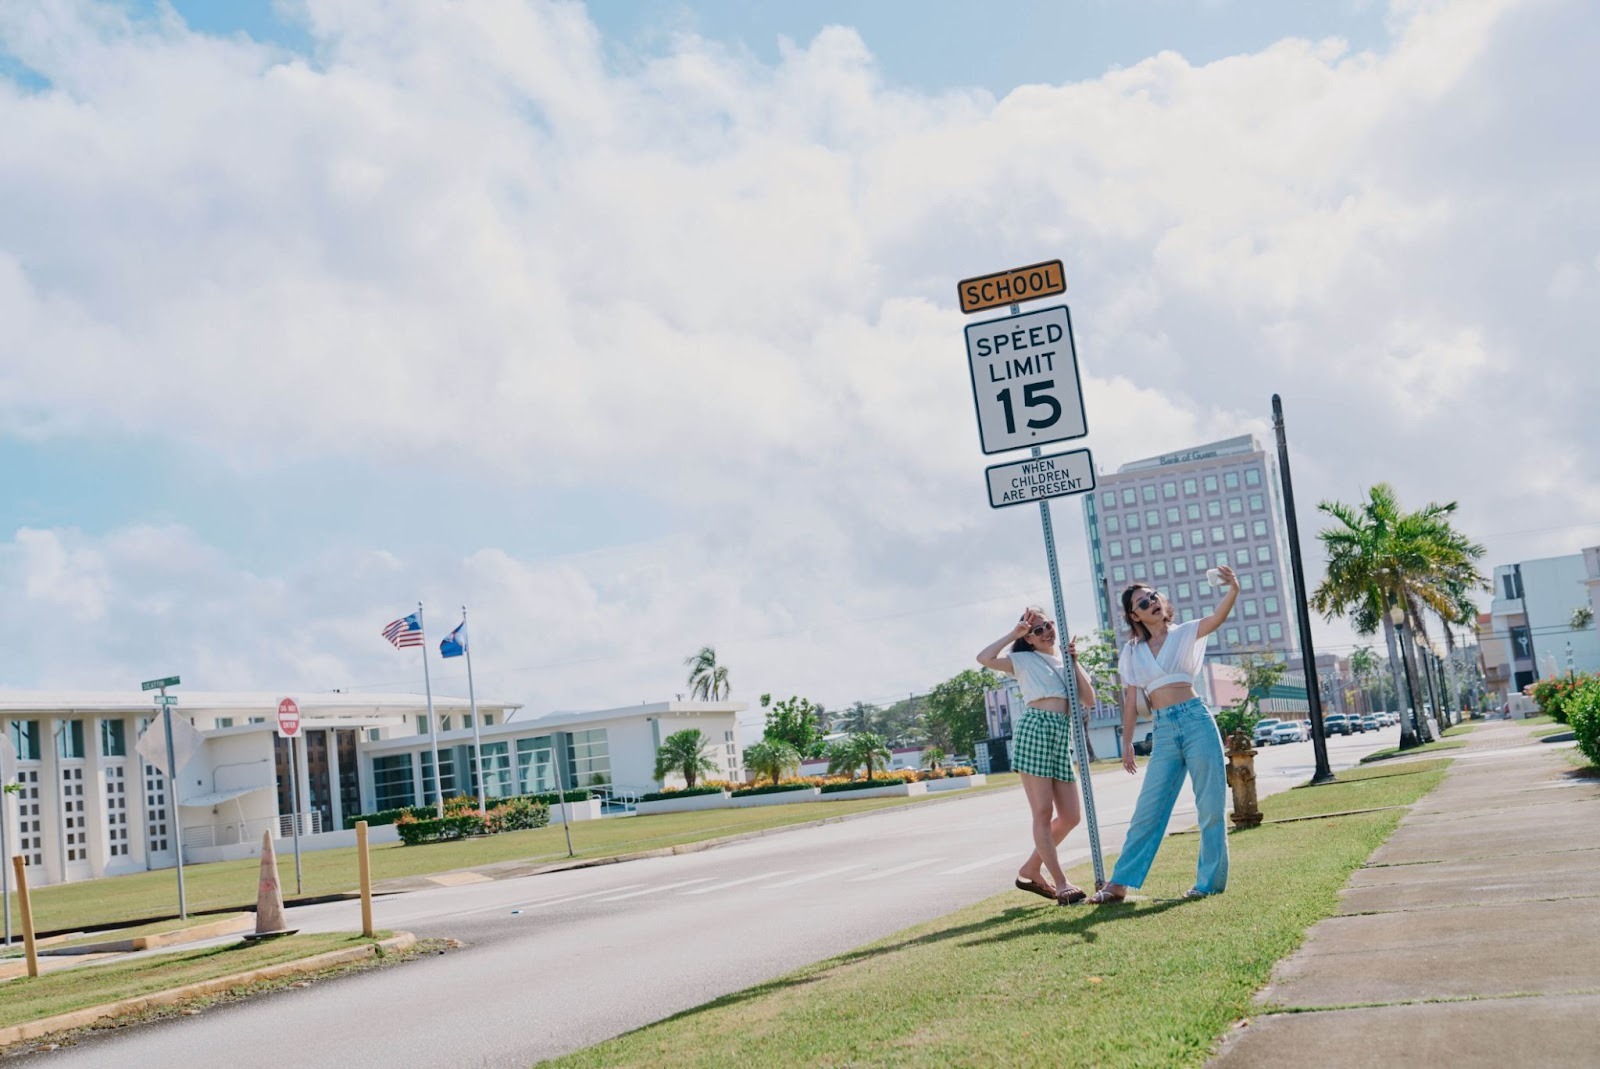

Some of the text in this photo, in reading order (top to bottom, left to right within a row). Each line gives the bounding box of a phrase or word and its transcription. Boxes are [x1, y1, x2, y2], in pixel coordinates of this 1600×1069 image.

[966, 270, 1059, 305] SCHOOL
[977, 323, 1063, 357] SPEED
[989, 351, 1056, 383] LIMIT
[996, 379, 1062, 434] 15
[1022, 460, 1055, 475] WHEN
[1160, 450, 1217, 465] Bank of Guam
[1003, 477, 1082, 502] ARE PRESENT
[1011, 468, 1070, 489] CHILDREN
[282, 721, 296, 729] ENTER
